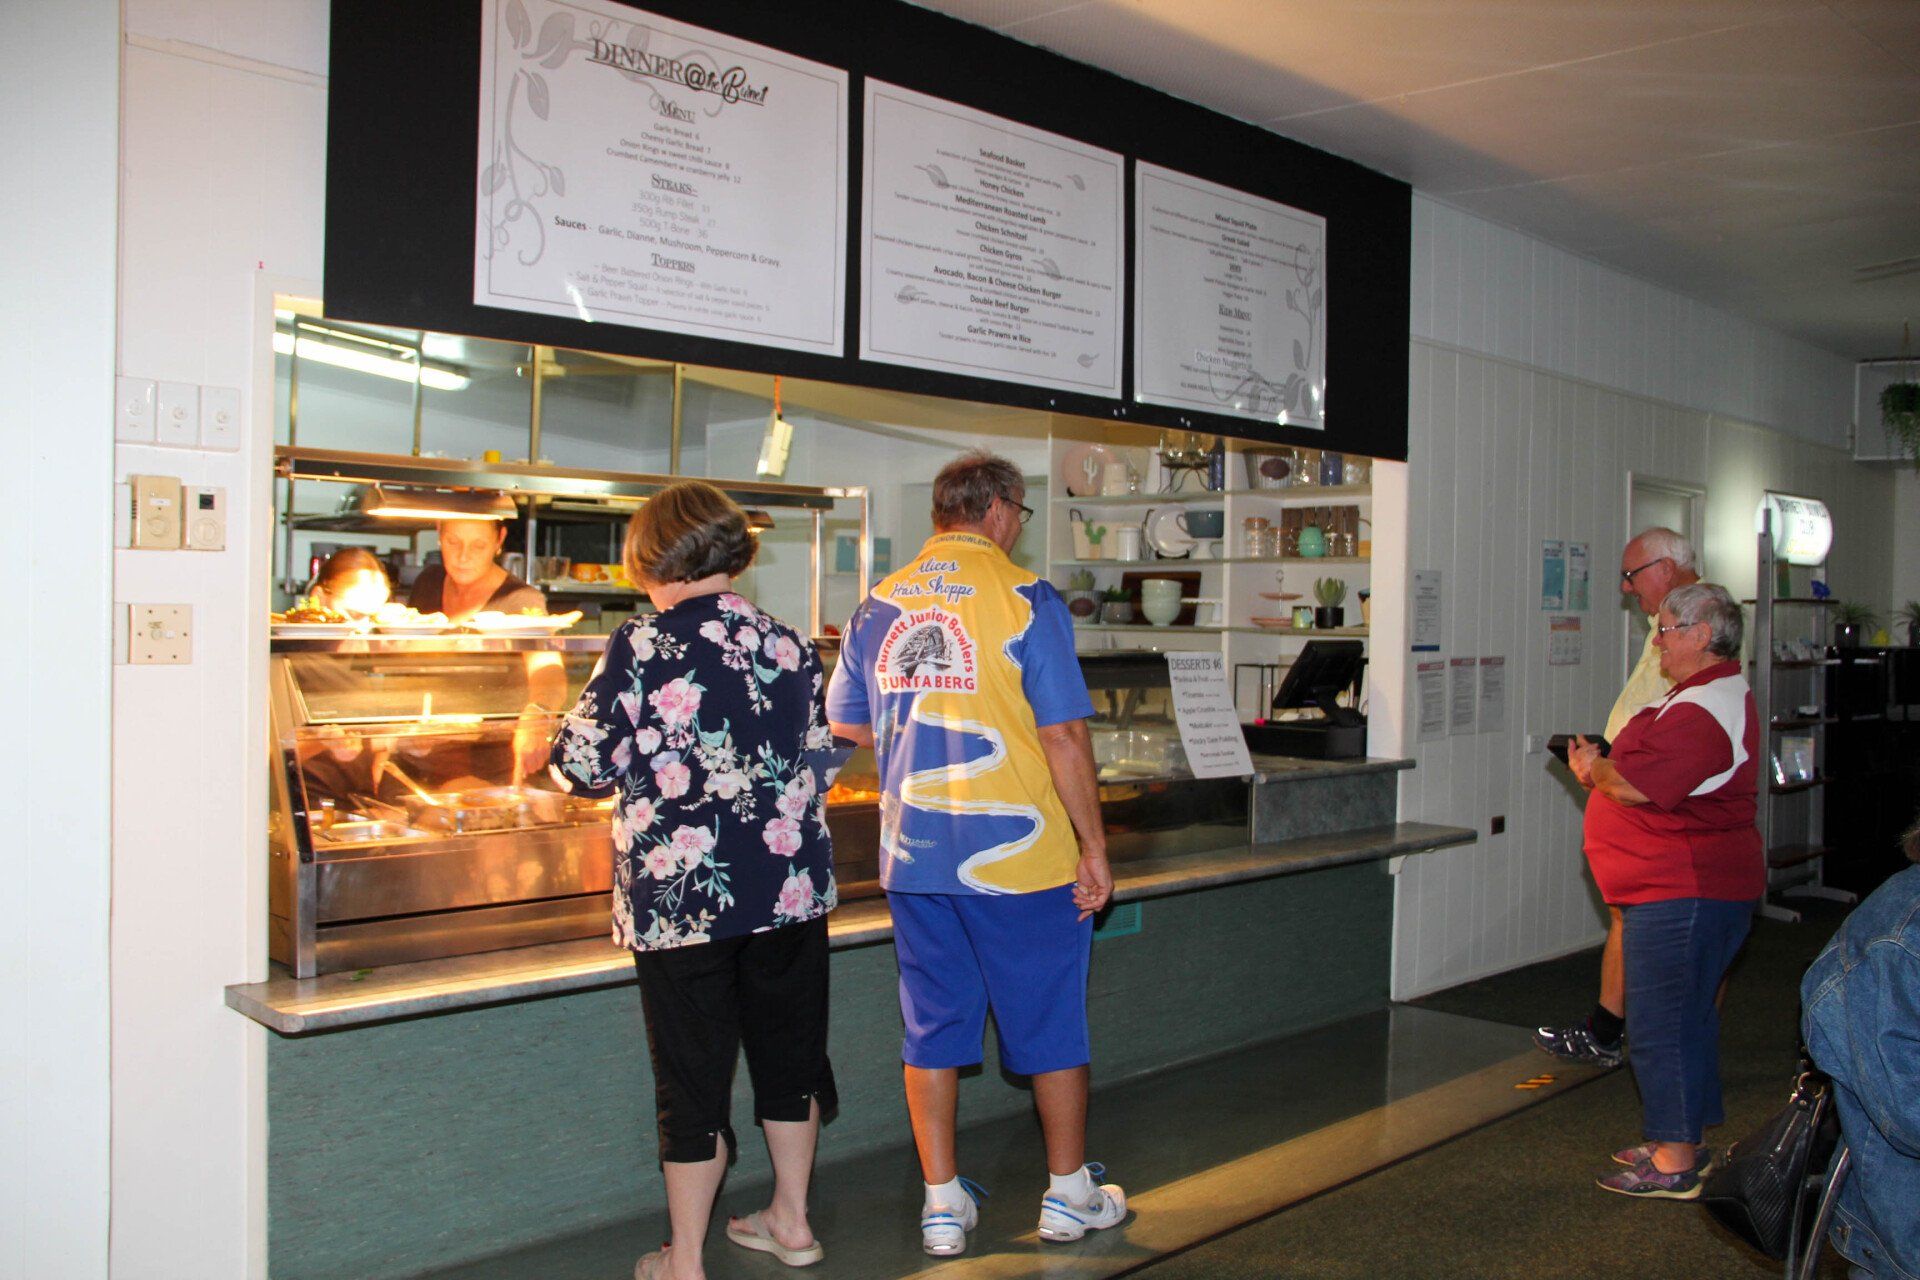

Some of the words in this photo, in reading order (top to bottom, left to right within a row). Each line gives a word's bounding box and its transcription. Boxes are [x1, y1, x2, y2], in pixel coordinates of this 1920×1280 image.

[654, 123, 670, 132] Garlic
[674, 128, 691, 138] Bread
[666, 138, 682, 147] Garlic
[686, 142, 703, 152] Bread
[979, 148, 1003, 162] Seafood
[1006, 156, 1024, 168] Basket
[980, 179, 998, 192] Honey
[1001, 185, 1023, 197] Chicken
[632, 204, 652, 216] 350g
[656, 209, 676, 221] Rump
[680, 213, 699, 224] Steak
[956, 194, 1001, 213] Mediterranean
[1004, 207, 1027, 219] Roasted
[1029, 214, 1045, 224] Lamb
[640, 218, 660, 231] 500g
[671, 224, 689, 234] Bone
[975, 221, 999, 233] Chicken
[1001, 227, 1026, 241] Schnitzel
[1215, 213, 1230, 223] Mixed
[1245, 221, 1256, 230] Plate
[555, 215, 585, 230] Sauces
[599, 225, 623, 238] Garlic,
[627, 230, 656, 244] Dianne,
[660, 237, 702, 252] Mushroom,
[706, 246, 748, 262] Peppercorn
[1222, 233, 1235, 243] Greek
[1237, 238, 1249, 247] Salad
[980, 244, 1003, 256] Chicken
[1005, 250, 1021, 261] Gyros
[651, 253, 694, 272] TOPPERS
[576, 271, 589, 281] Salt
[601, 276, 625, 288] Pepper
[628, 281, 646, 292] Squid
[621, 267, 649, 279] Battered
[653, 272, 672, 282] Onion
[675, 276, 692, 288] Rings
[934, 265, 964, 279] Avocado,
[967, 272, 985, 283] Bacon
[995, 278, 1015, 289] Cheese
[1018, 283, 1039, 294] Chicken
[1042, 289, 1061, 300] Burger
[588, 287, 606, 298] Garlic
[610, 291, 631, 302] Prawn
[635, 295, 657, 306] Topper
[970, 294, 992, 305] Double
[995, 299, 1008, 308] Beef
[1010, 303, 1029, 314] Burger
[967, 324, 985, 335] Garlic
[988, 328, 1010, 339] Prawns
[1019, 334, 1031, 343] Rice
[1196, 351, 1219, 364] Chicken
[890, 581, 922, 598] Hair
[923, 575, 975, 605] Shoppe
[878, 619, 908, 673] Burnett
[910, 607, 949, 627] Junior
[948, 618, 974, 673] Bowlers
[1171, 658, 1211, 670] DESSERTS
